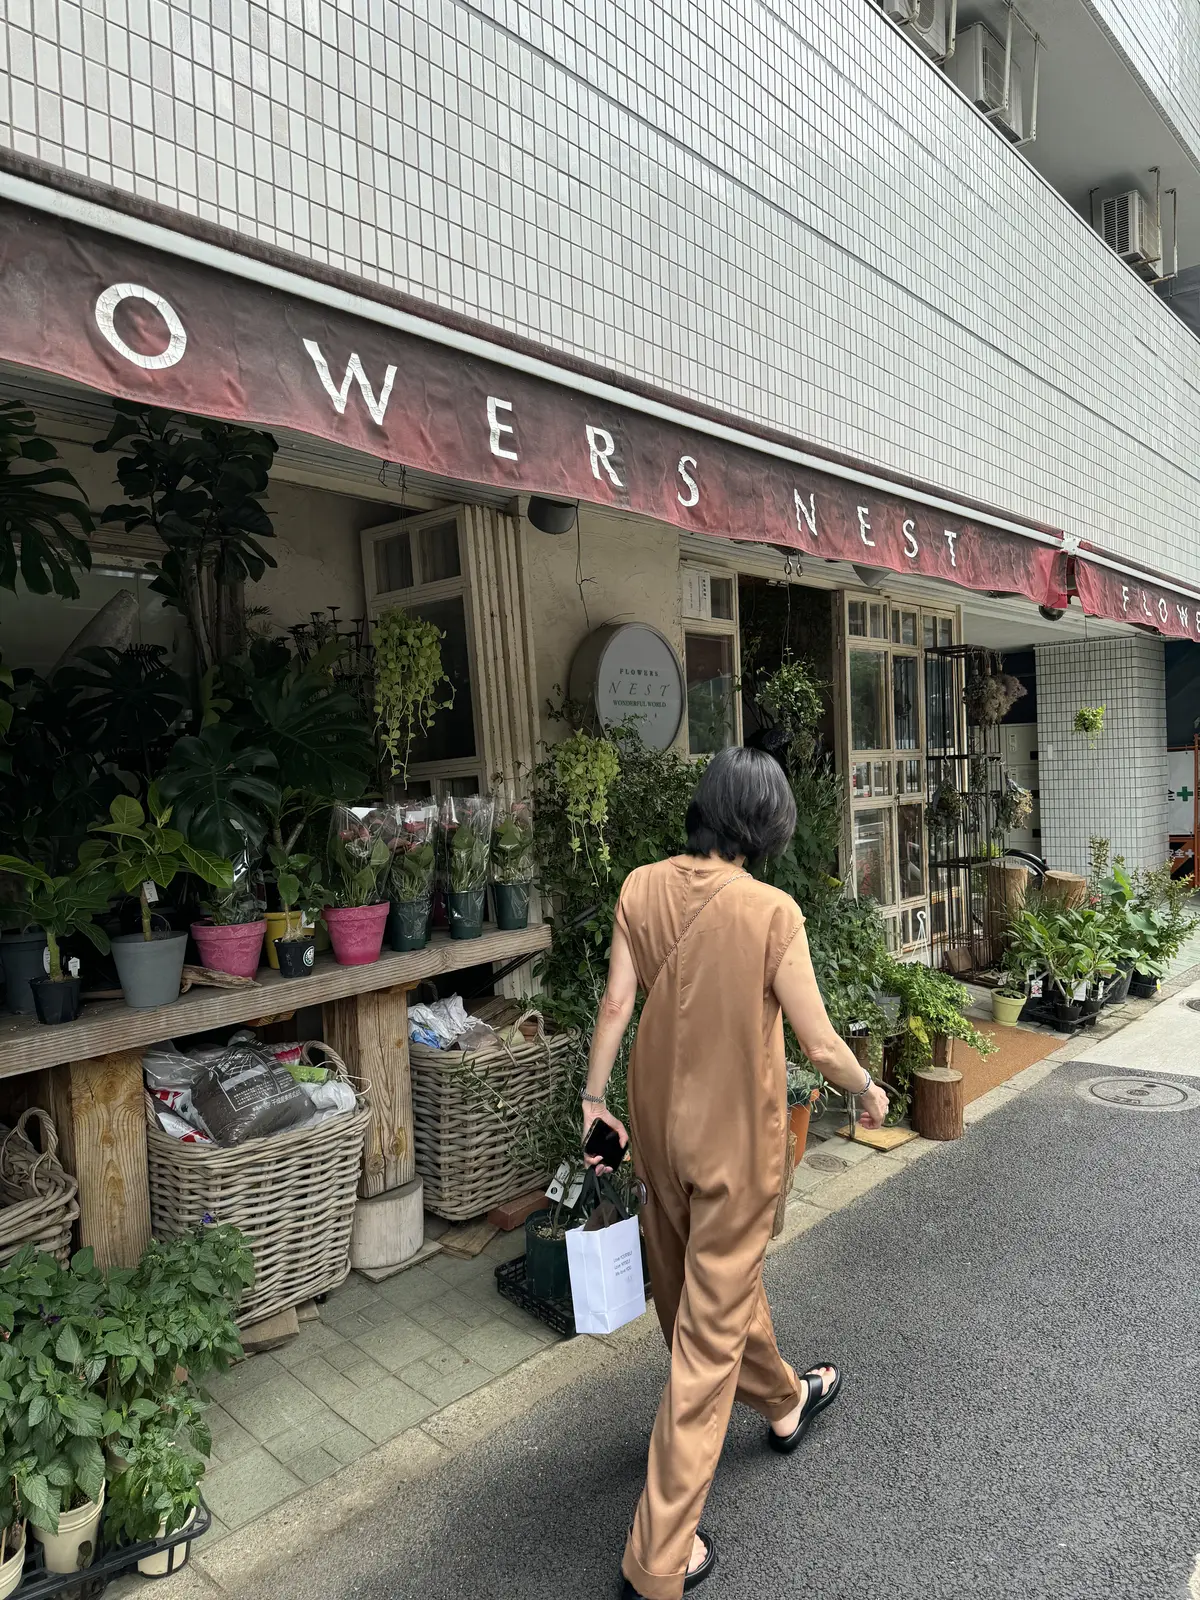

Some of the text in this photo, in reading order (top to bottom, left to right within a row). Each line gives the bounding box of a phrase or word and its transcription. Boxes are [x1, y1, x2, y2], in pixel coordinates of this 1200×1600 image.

[794, 487, 959, 568] NEST
[619, 667, 659, 677] FLOWERS
[608, 680, 671, 697] NEST
[612, 699, 647, 707] WONDERFUL
